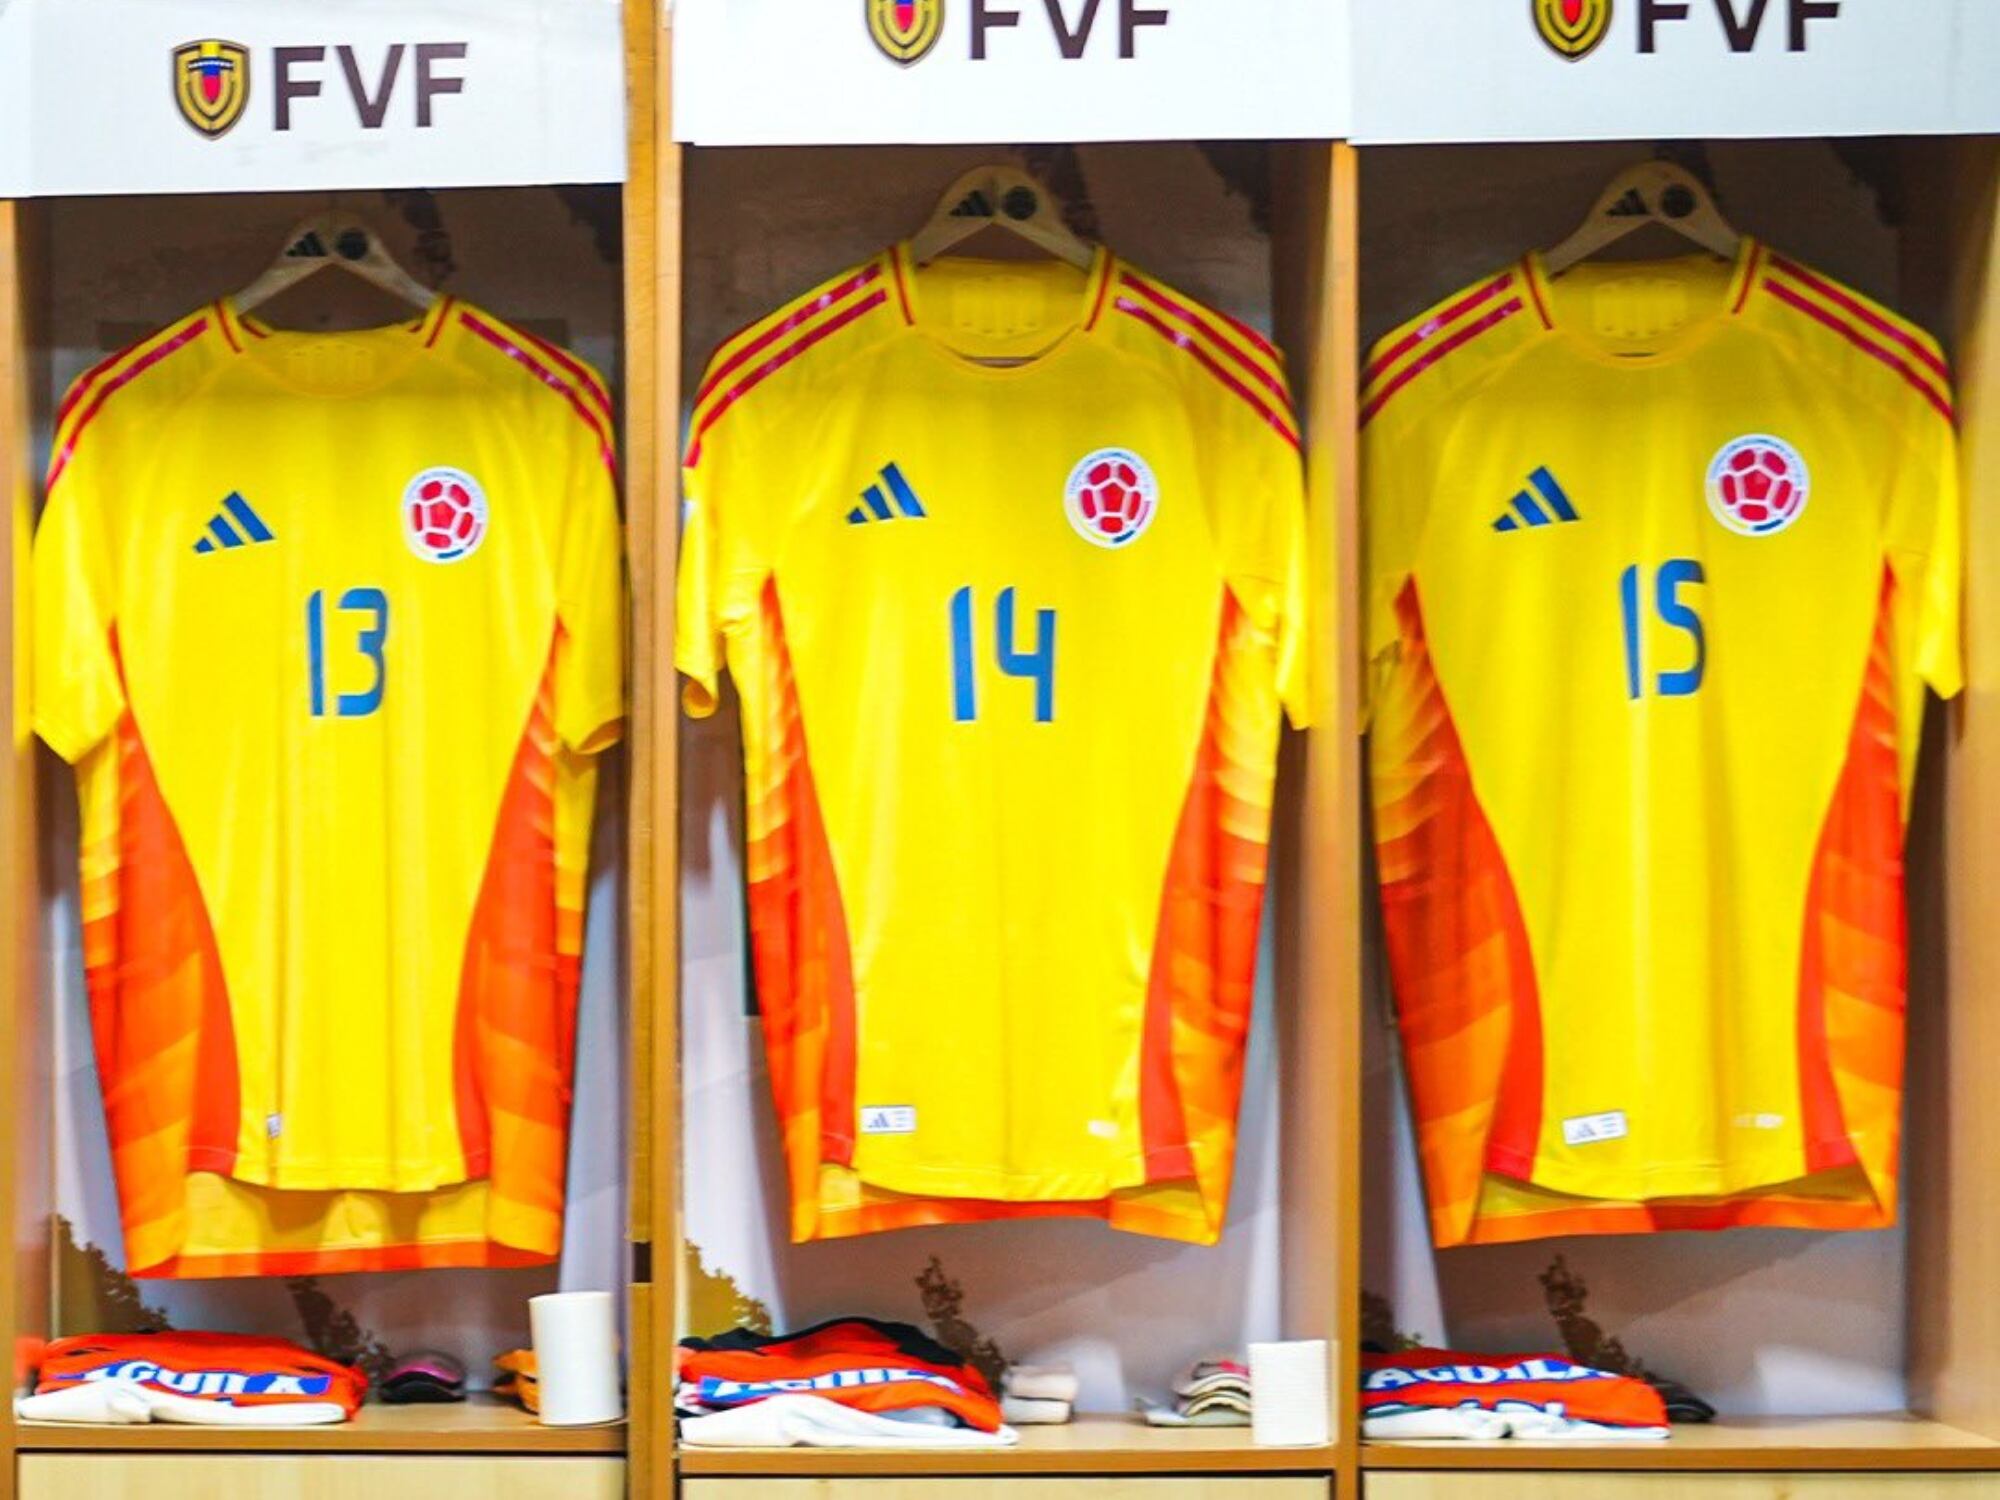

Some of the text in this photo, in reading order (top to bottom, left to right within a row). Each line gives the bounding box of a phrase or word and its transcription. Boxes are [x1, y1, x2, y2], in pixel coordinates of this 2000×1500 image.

[971, 0, 1169, 60] FVF
[1636, 0, 1841, 54] FVF
[272, 42, 468, 132] FVF
[307, 587, 388, 717] 13
[951, 586, 1057, 723] 14
[1620, 558, 1707, 700] 15
